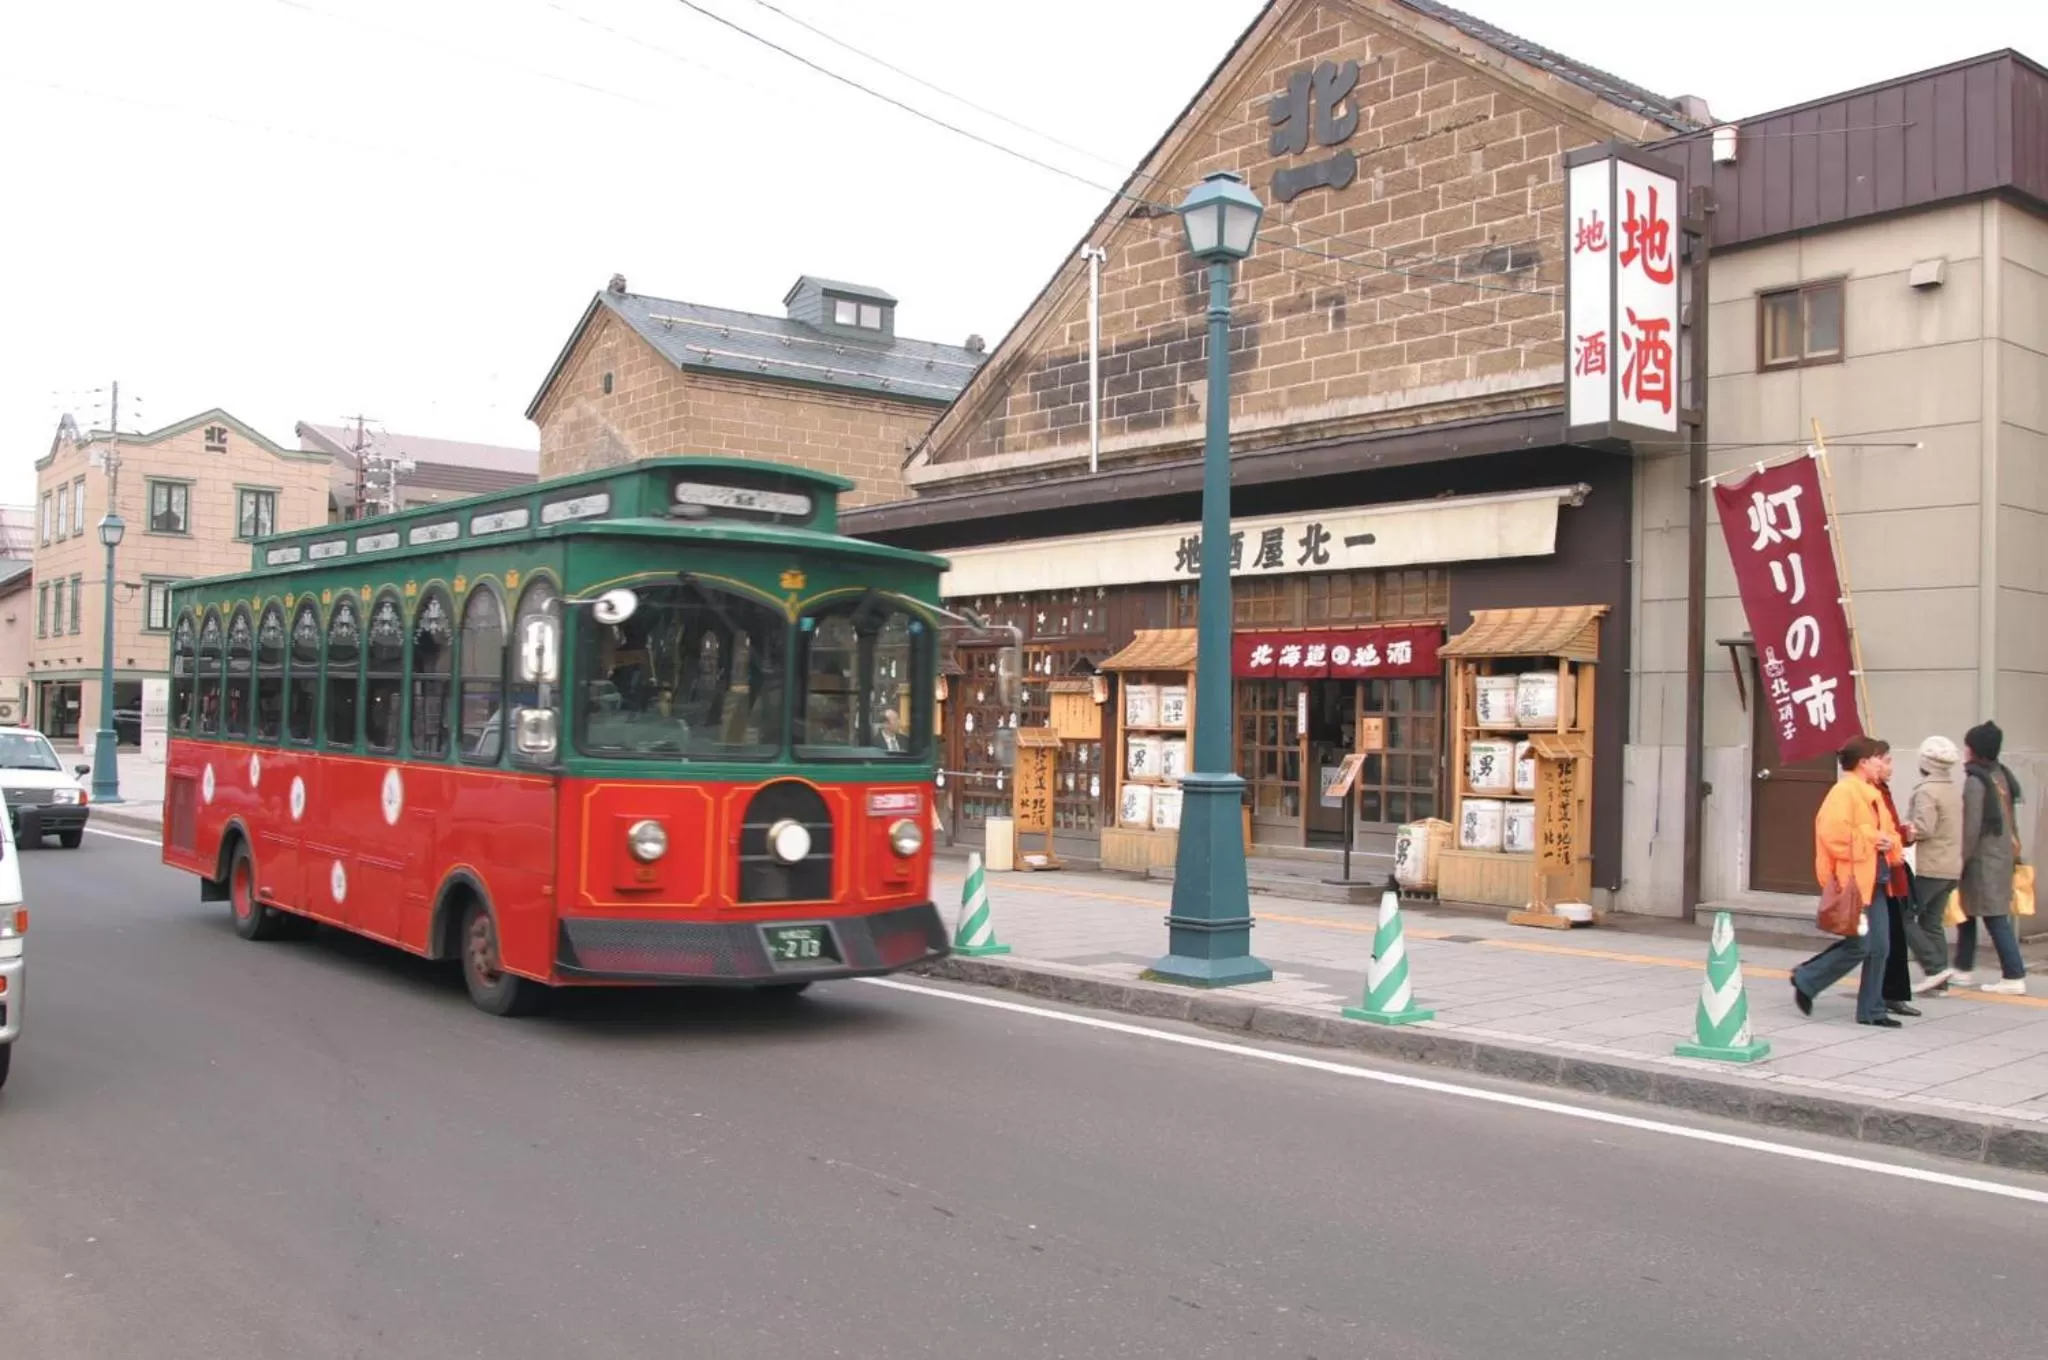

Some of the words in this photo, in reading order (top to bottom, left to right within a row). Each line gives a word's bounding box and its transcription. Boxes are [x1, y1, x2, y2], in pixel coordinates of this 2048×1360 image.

[1268, 59, 1360, 203] 北一
[1573, 209, 1608, 377] 地酒
[1618, 185, 1675, 414] 地酒
[1250, 640, 1413, 669] 北海道の地酒
[1747, 484, 1839, 732] 灯りの市
